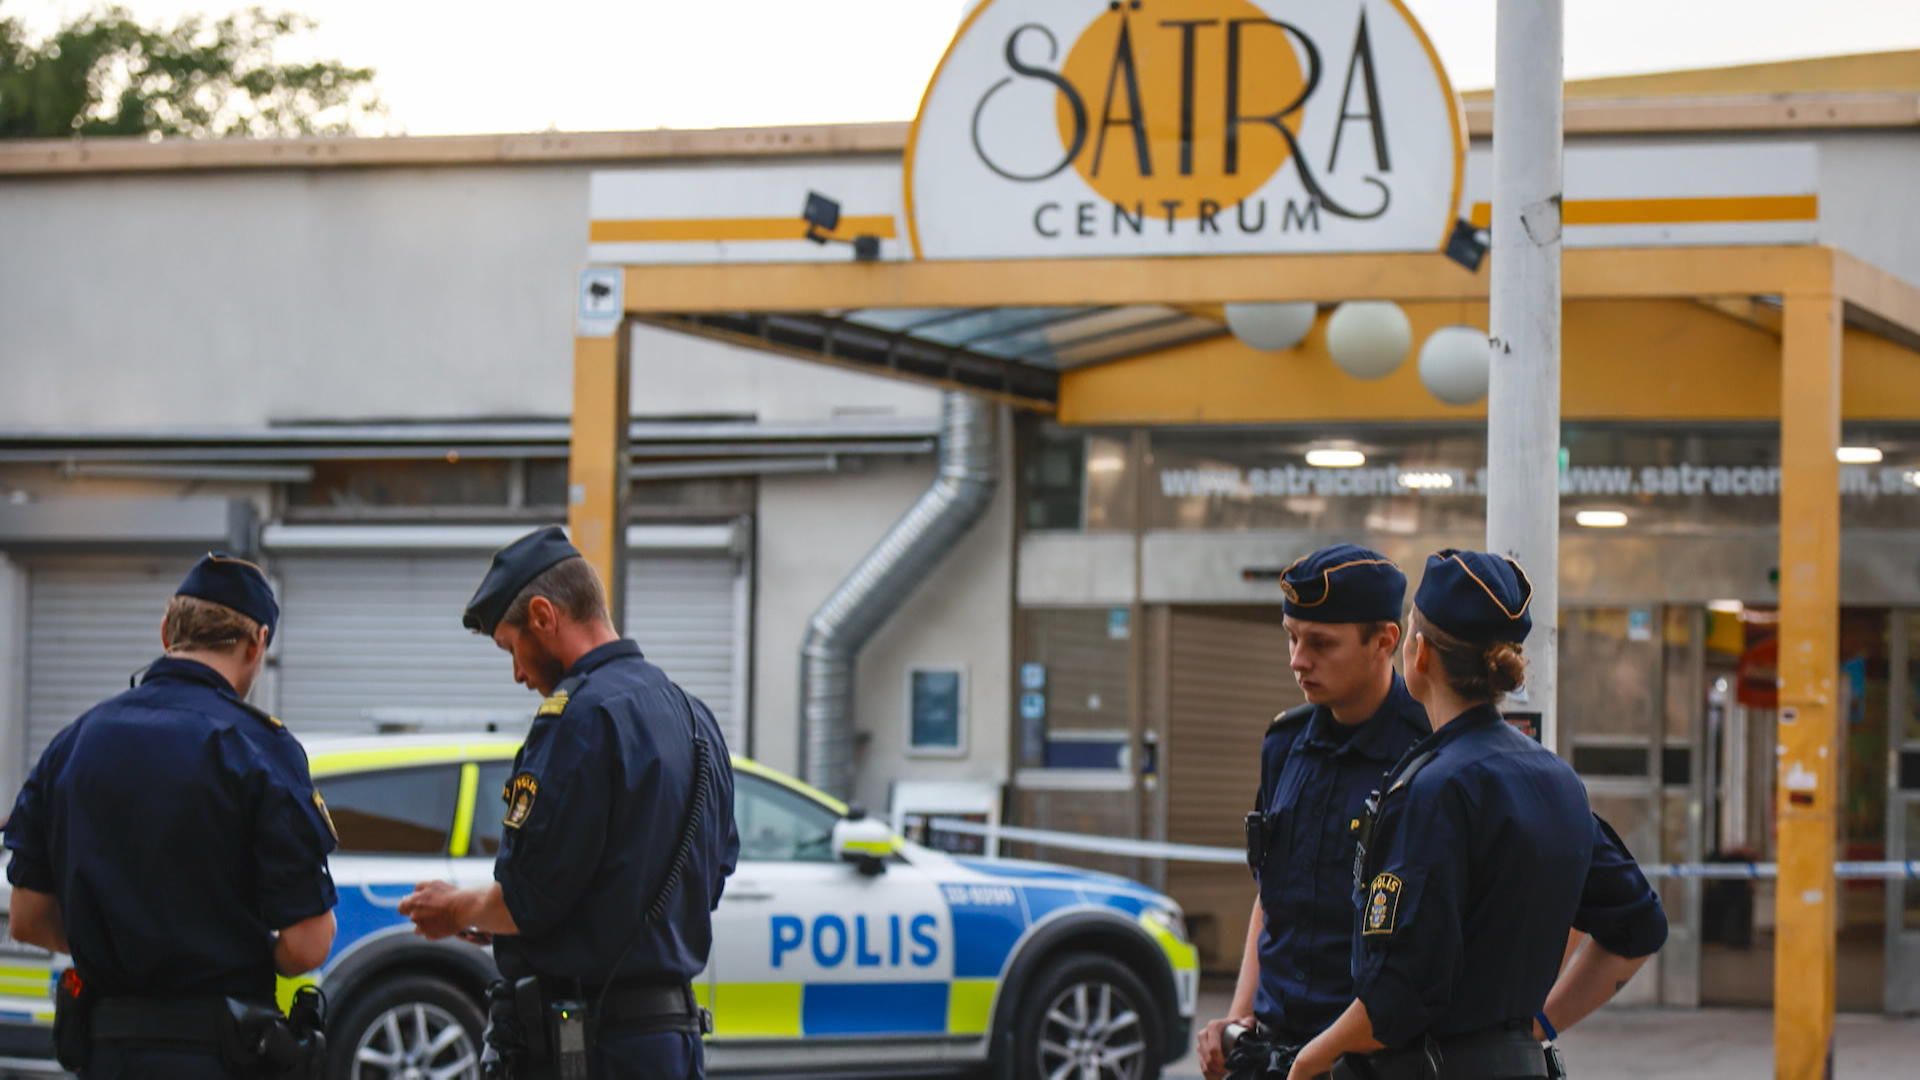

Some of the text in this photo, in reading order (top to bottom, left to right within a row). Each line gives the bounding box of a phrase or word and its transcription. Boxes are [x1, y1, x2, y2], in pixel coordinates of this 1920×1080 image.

[971, 0, 1392, 220] SÄTRA
[1033, 199, 1322, 237] CENTRUM
[1372, 875, 1399, 894] POLIS
[769, 913, 939, 968] POLIS
